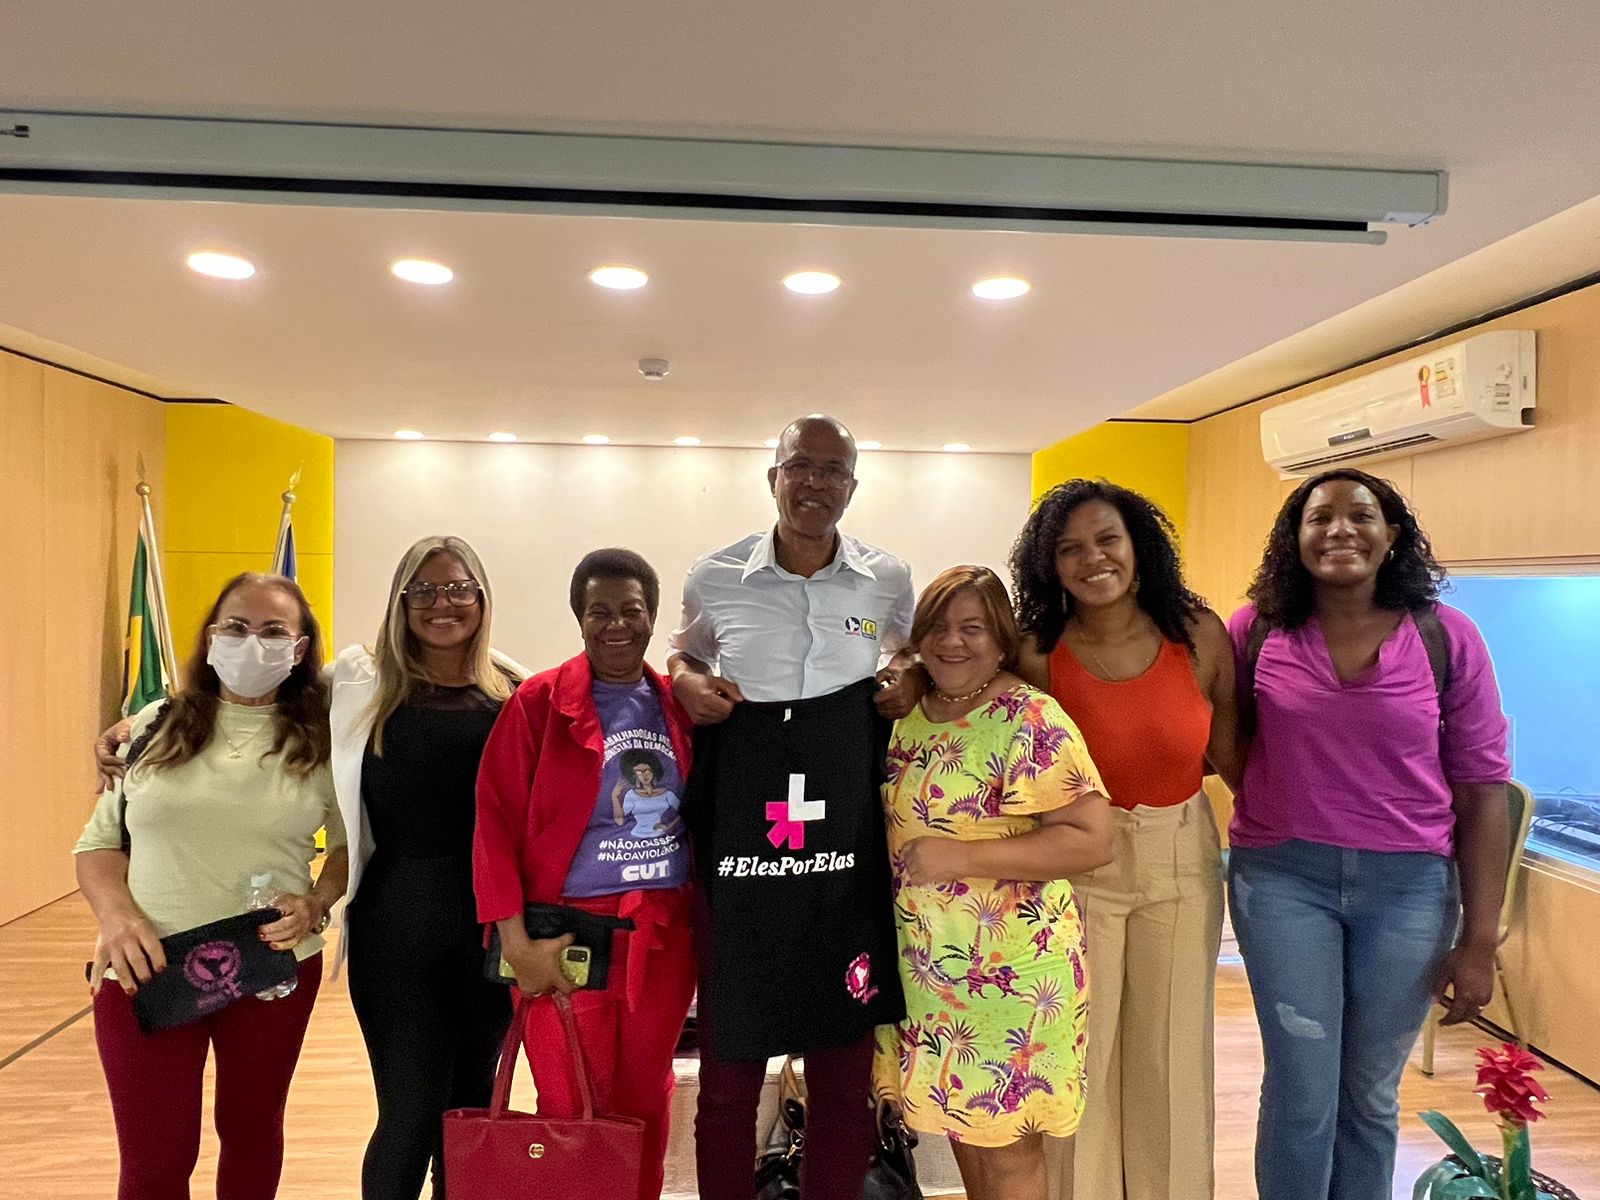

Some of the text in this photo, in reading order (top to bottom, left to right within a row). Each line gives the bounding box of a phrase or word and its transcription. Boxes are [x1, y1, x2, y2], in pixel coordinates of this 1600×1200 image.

[633, 738, 643, 749] DA
[622, 860, 670, 882] CUT
[717, 851, 855, 877] #ElesPorElas
